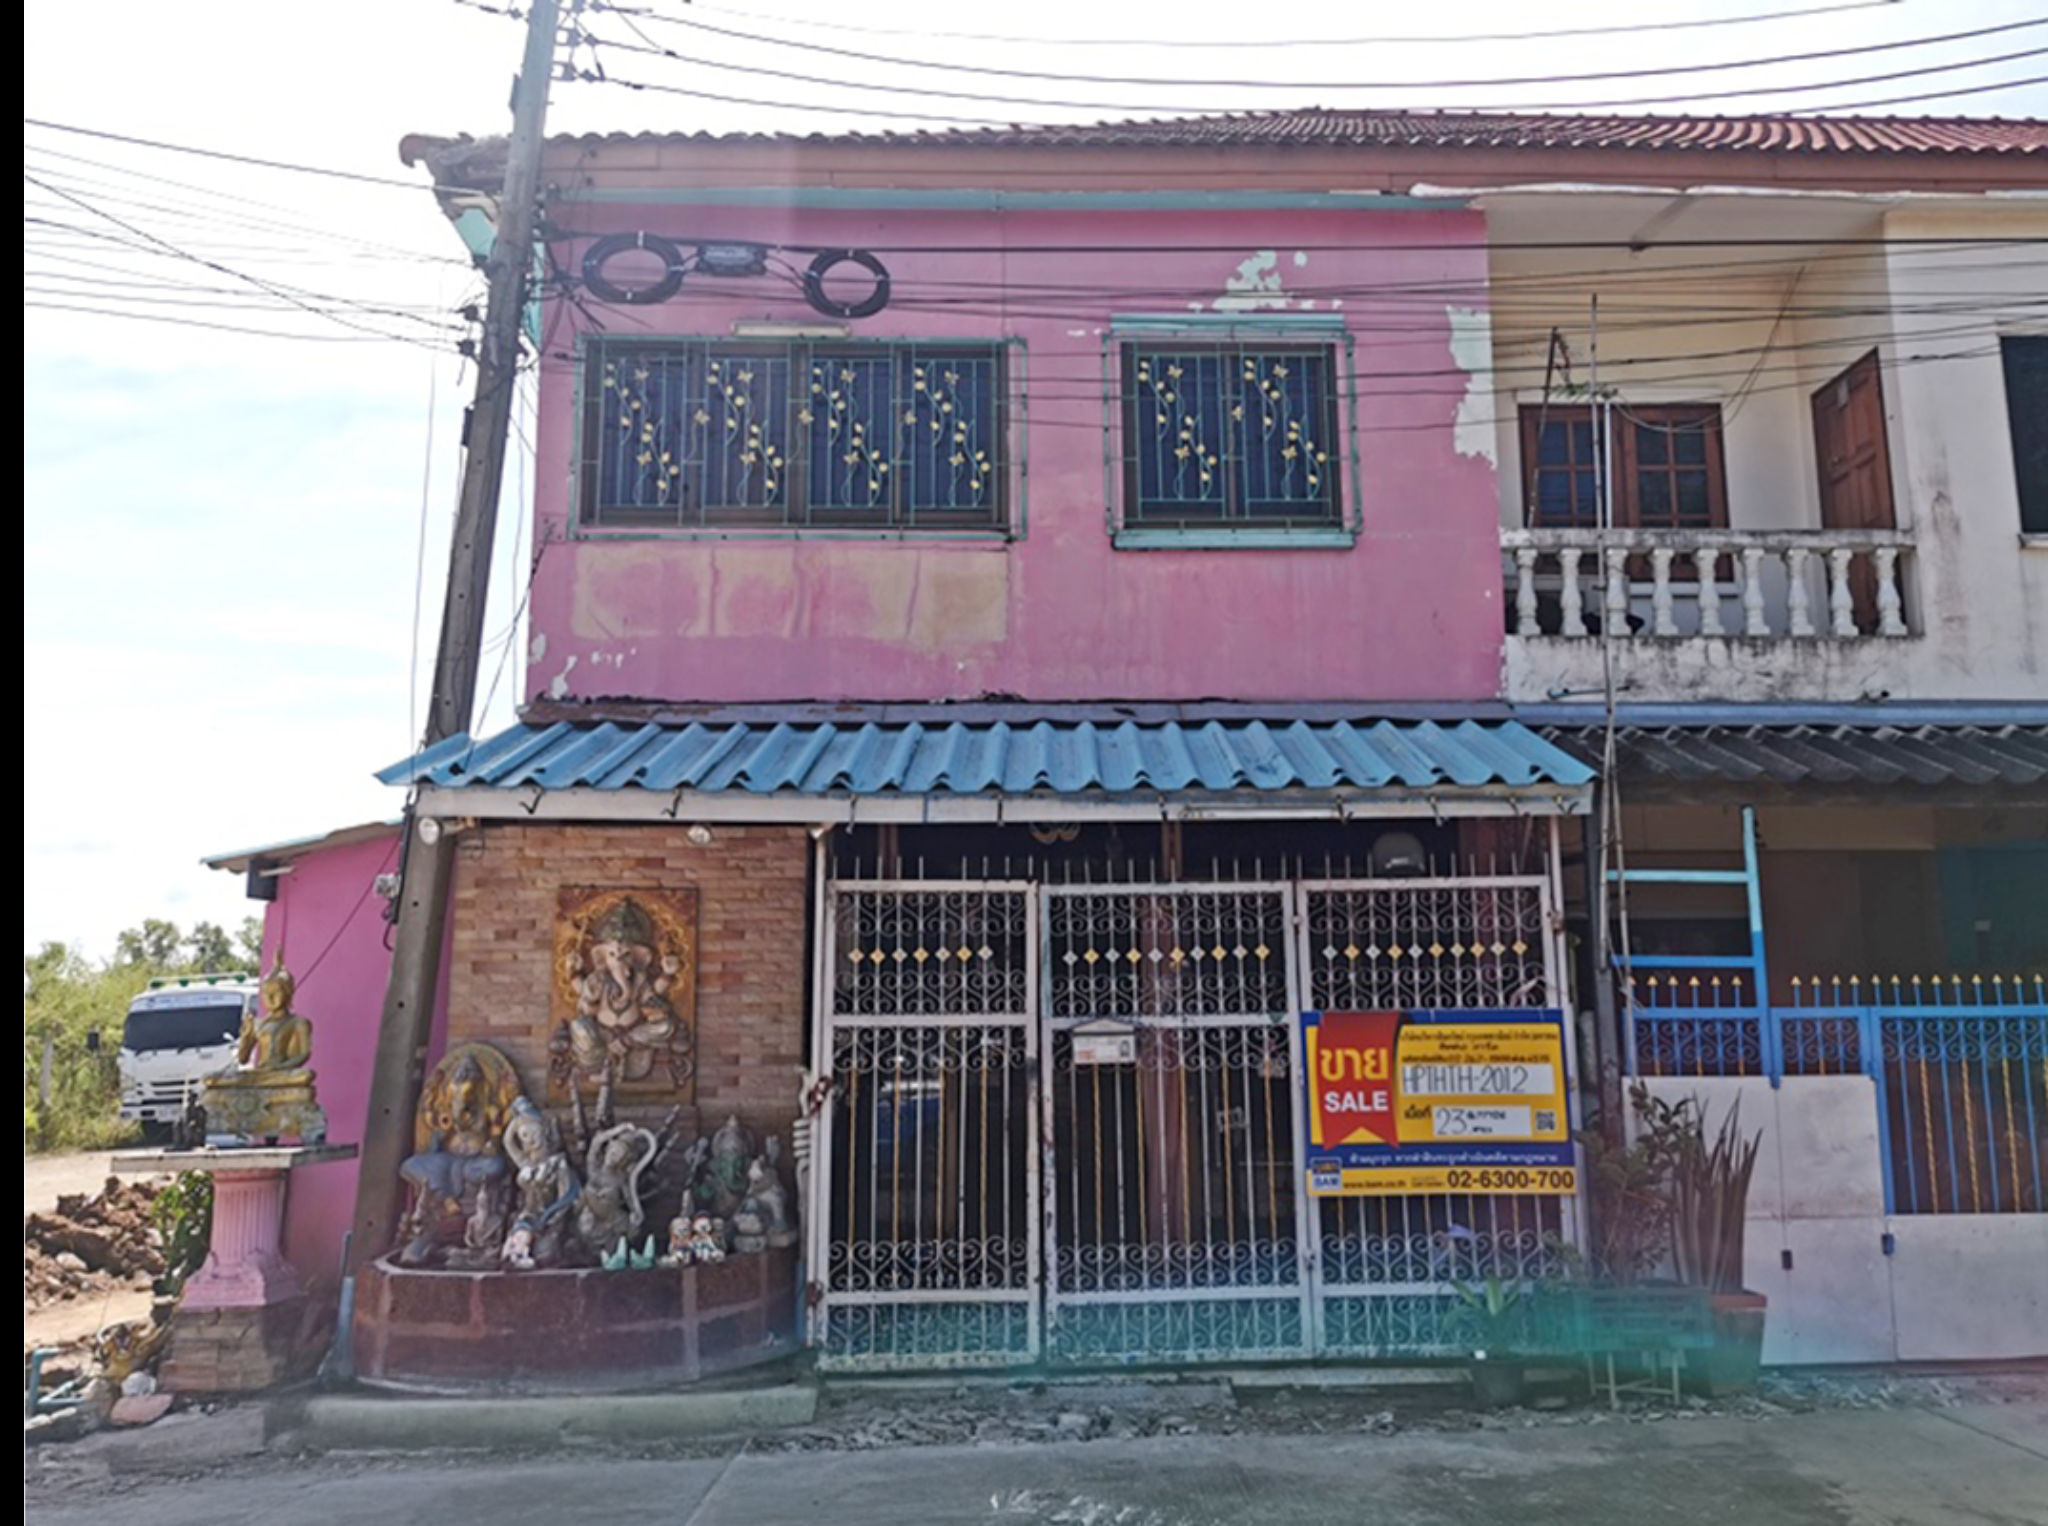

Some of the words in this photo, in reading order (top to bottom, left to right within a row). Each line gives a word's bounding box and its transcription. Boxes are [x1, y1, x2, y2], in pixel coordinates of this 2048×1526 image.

[1320, 1047, 1388, 1081] ขาย
[1325, 1090, 1388, 1113] SALE
[1436, 1107, 1467, 1135] 23
[1447, 1169, 1574, 1189] 02-6300-700
